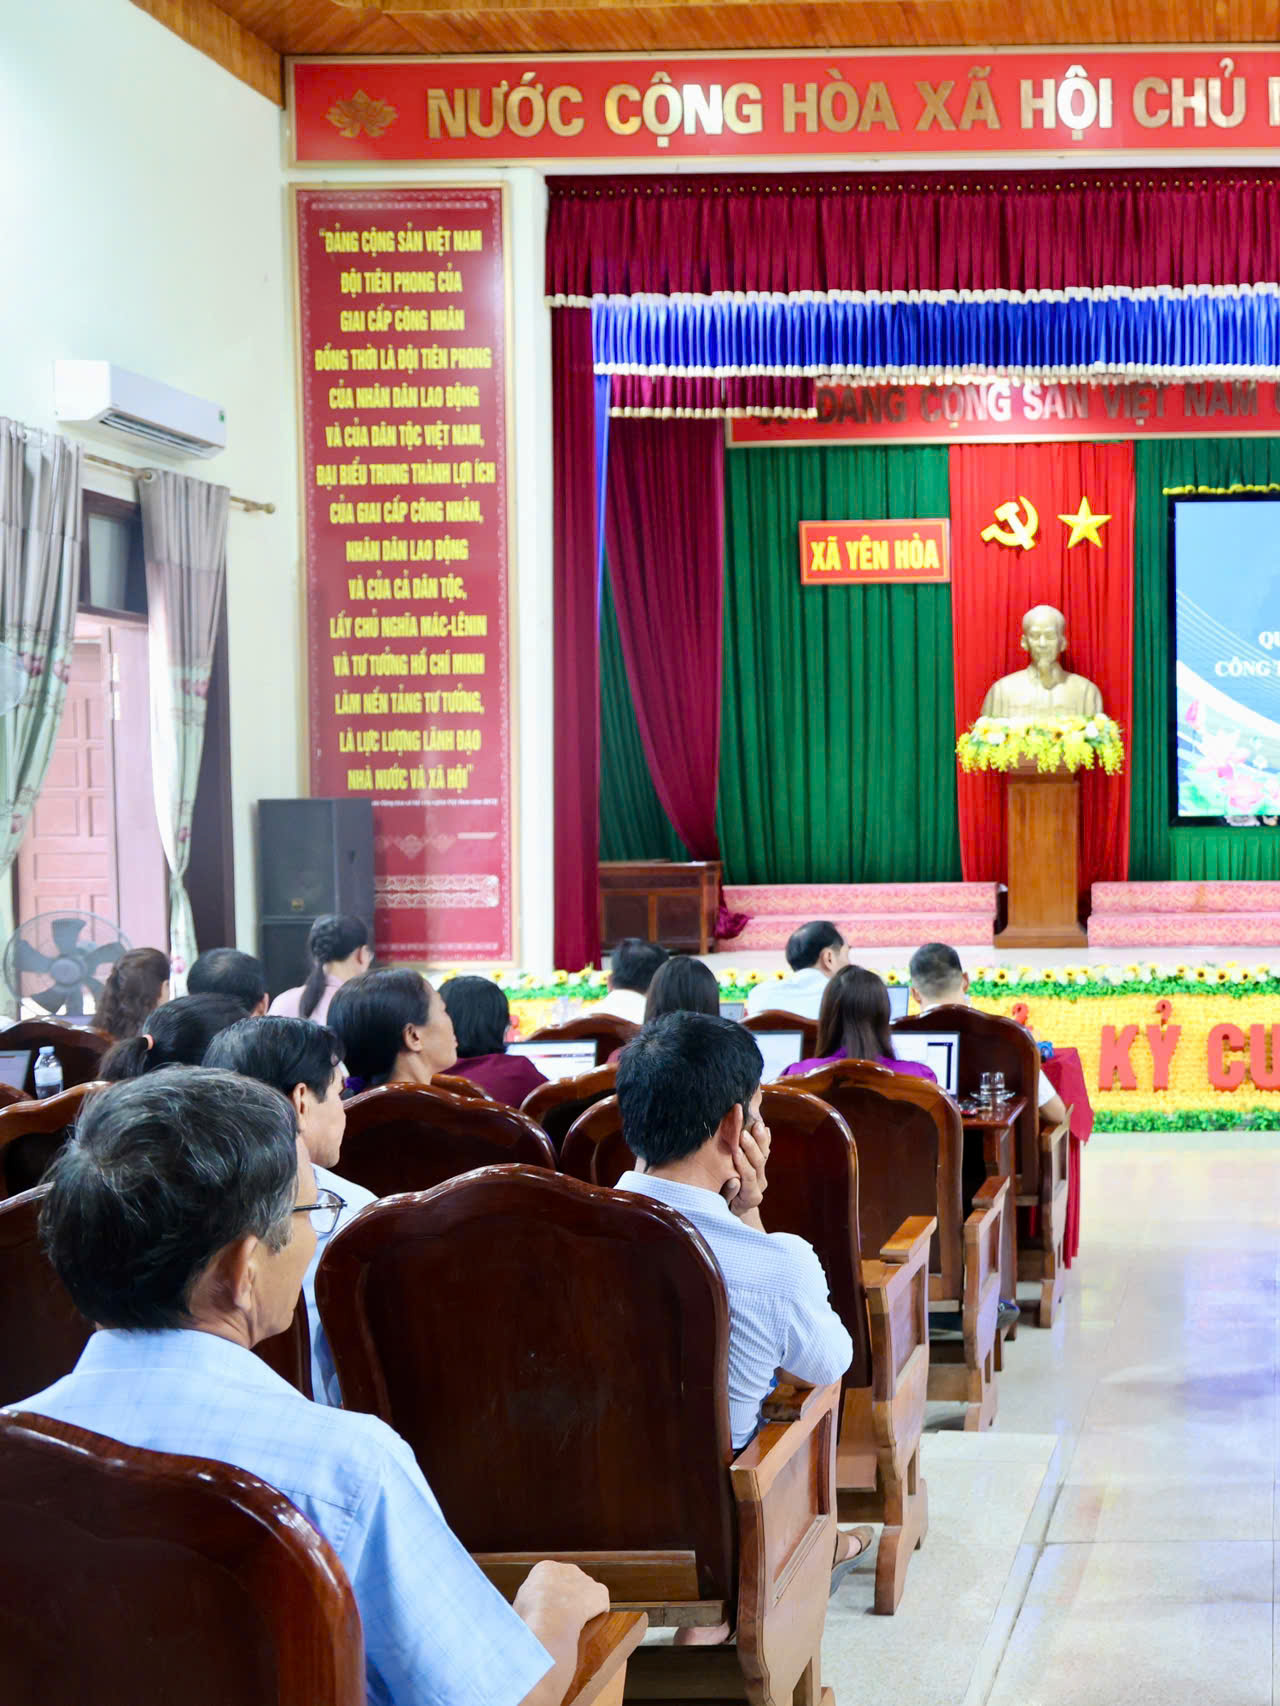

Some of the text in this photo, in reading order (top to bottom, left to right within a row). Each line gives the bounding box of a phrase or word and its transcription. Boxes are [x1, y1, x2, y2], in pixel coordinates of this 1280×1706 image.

[426, 72, 584, 139] NƯỚC
[604, 71, 763, 148] CỘNG
[782, 67, 899, 134] HÒA
[914, 65, 1001, 131] XÃ
[1020, 65, 1113, 141] HỘI
[1132, 57, 1246, 129] CHỦ
[1185, 380, 1258, 417] NAM
[810, 532, 940, 571] XÃ YÊN HÒA
[1098, 999, 1182, 1092] KỶ
